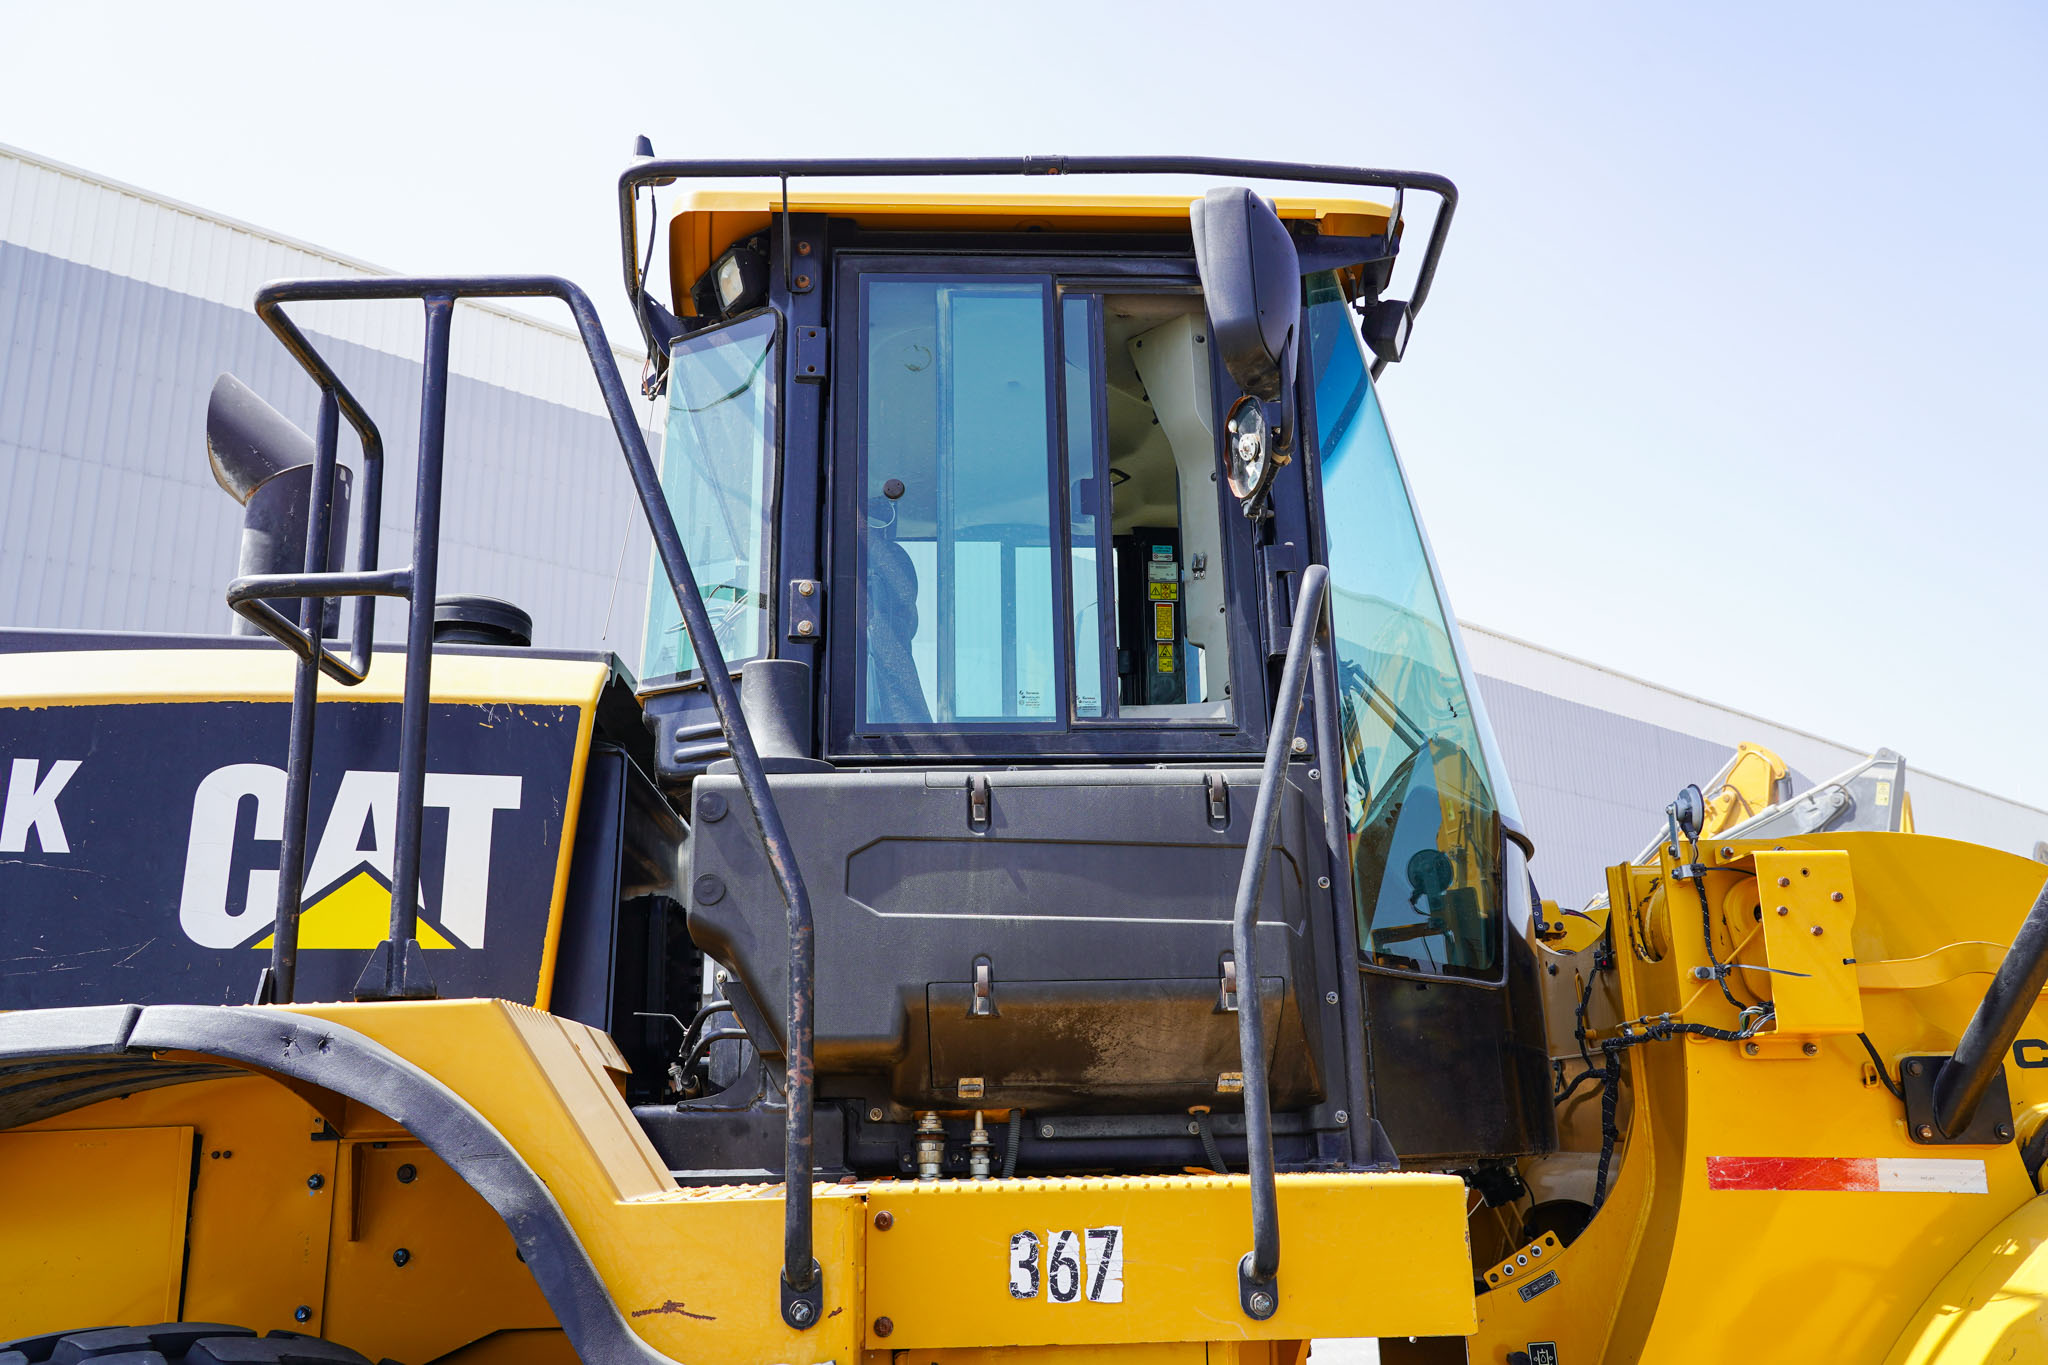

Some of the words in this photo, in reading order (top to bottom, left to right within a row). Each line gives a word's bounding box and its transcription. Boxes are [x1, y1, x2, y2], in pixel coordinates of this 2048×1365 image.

[0, 758, 83, 853] K
[179, 763, 522, 950] CAT
[1009, 1229, 1119, 1302] 367
